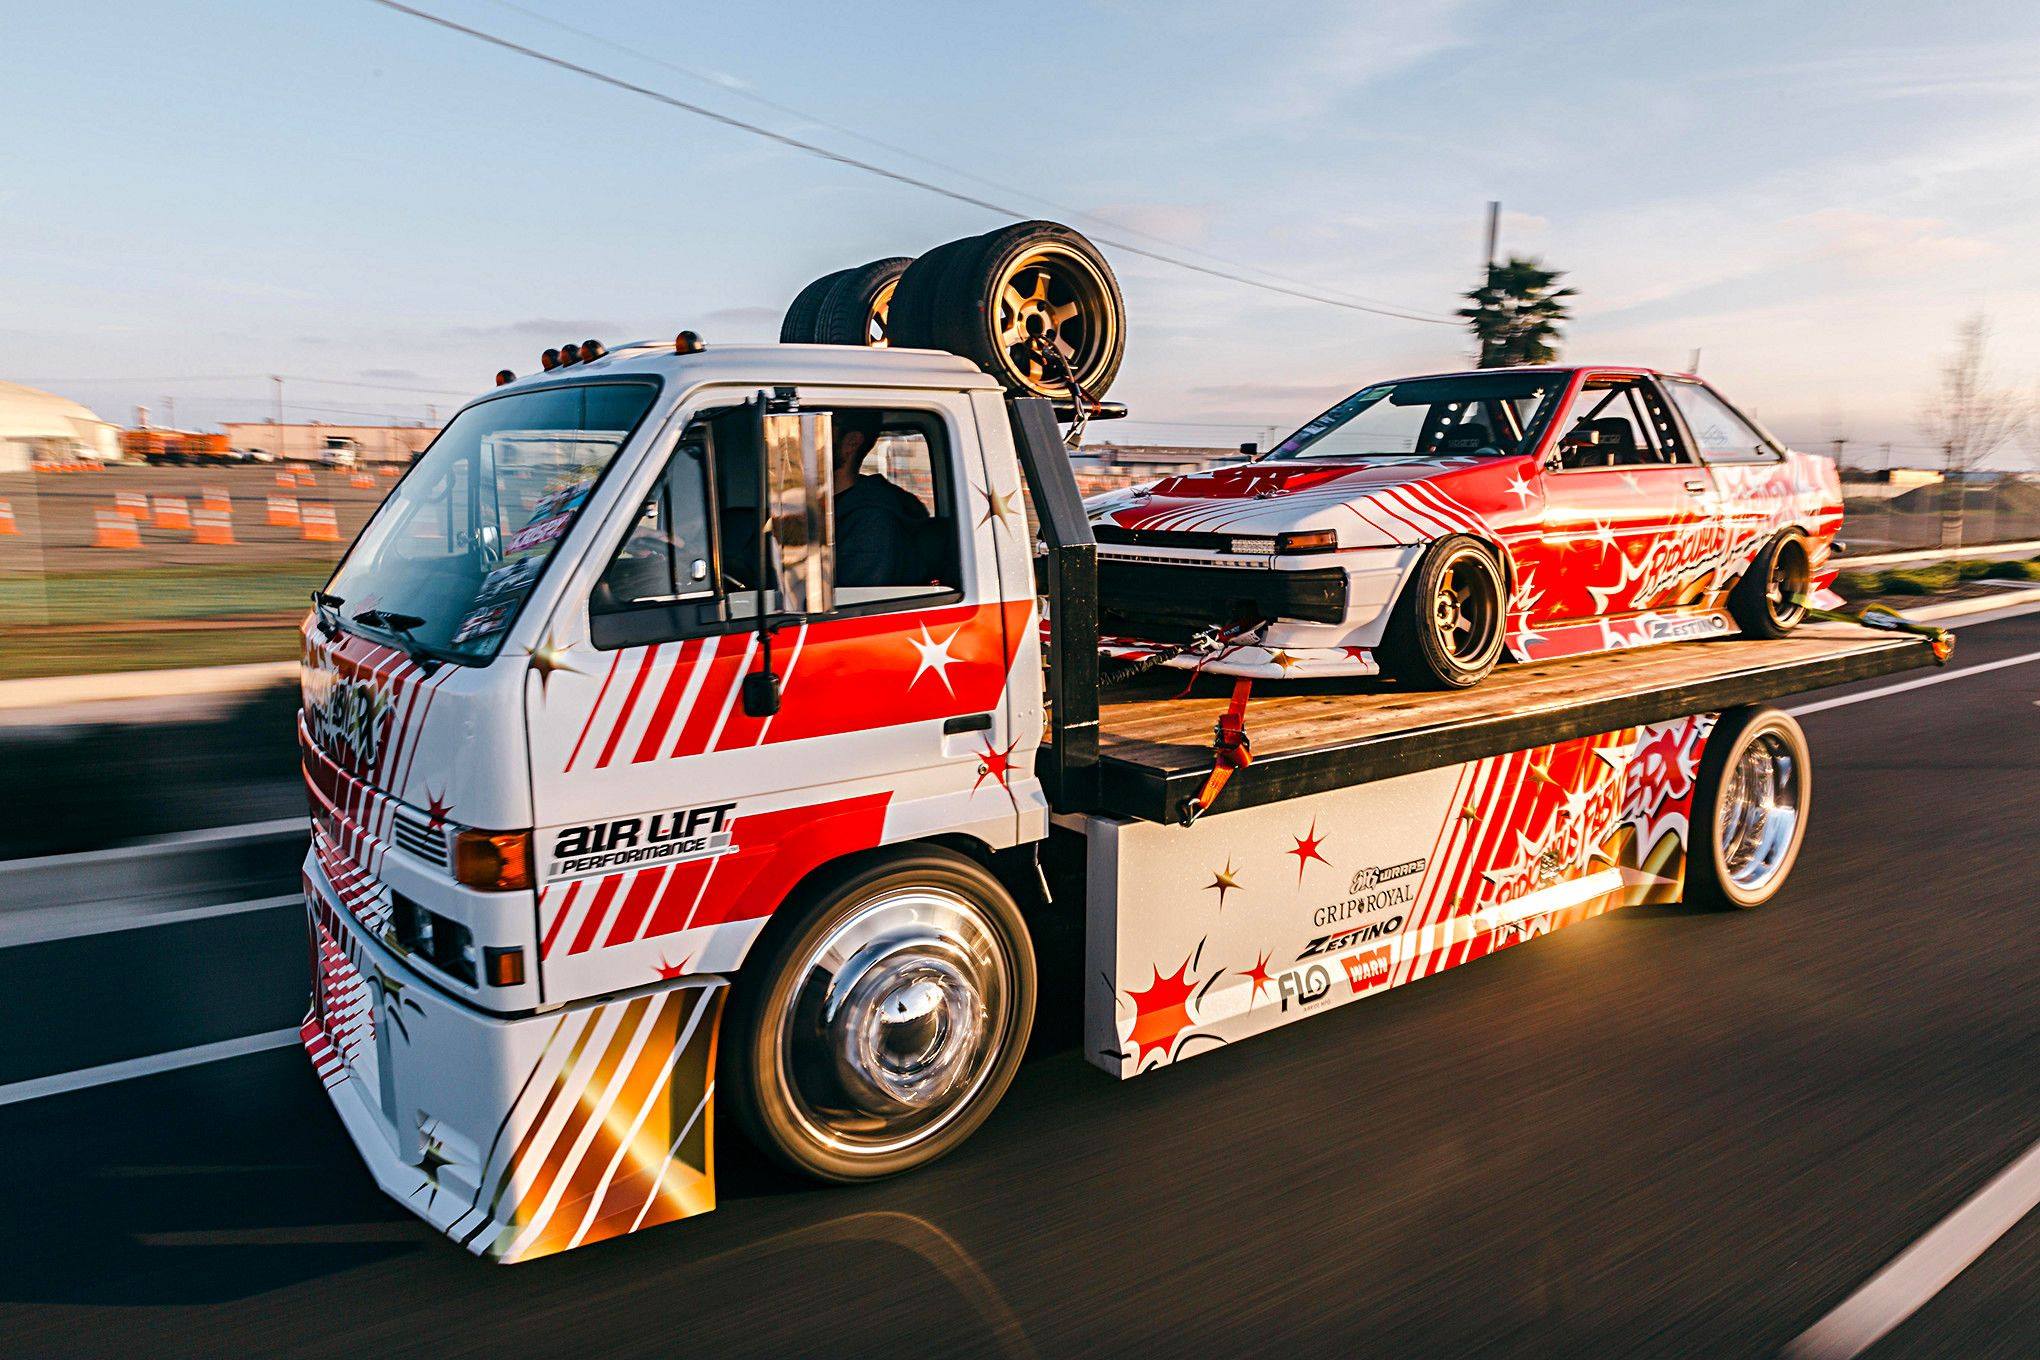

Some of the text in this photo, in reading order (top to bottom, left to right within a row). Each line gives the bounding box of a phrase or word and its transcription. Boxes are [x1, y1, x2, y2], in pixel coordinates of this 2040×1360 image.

[647, 803, 738, 843] LIFT
[1314, 885, 1413, 927] GRIP ROYAL
[1296, 916, 1403, 962] ZESTINO
[1350, 957, 1388, 982] WARN
